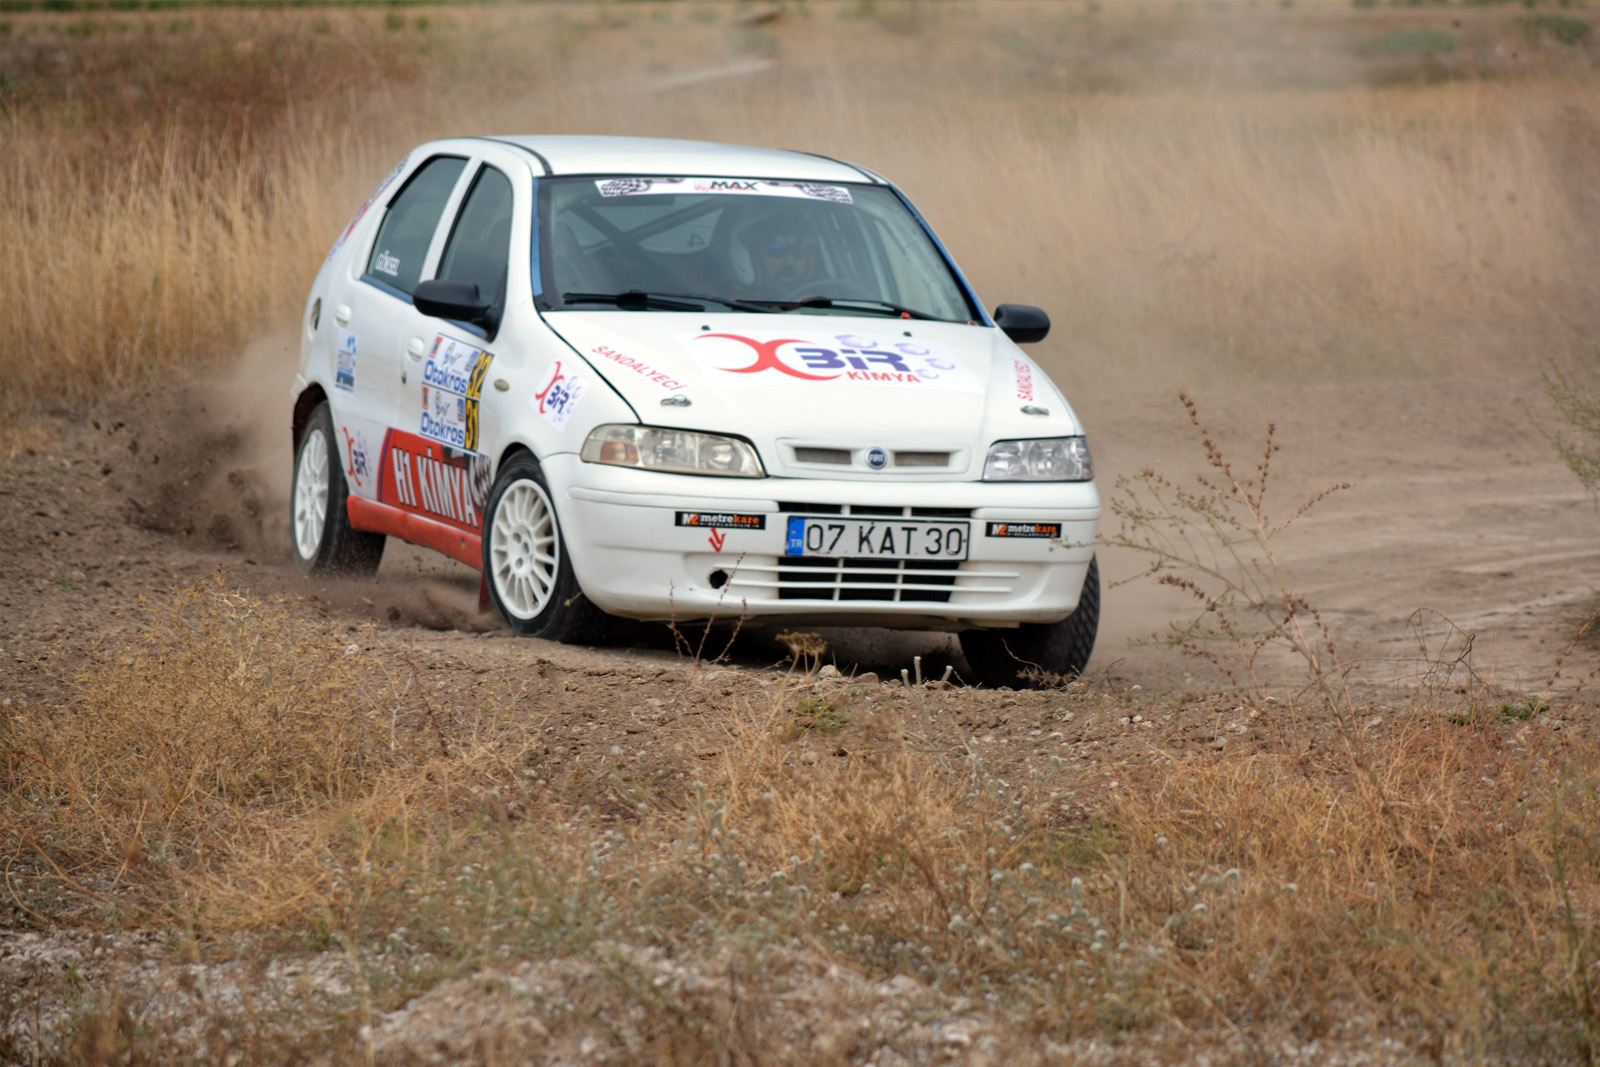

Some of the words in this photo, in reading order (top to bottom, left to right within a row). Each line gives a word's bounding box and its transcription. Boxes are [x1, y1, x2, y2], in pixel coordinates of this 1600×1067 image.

[711, 181, 759, 192] MAX
[424, 359, 468, 395] Otokros
[421, 411, 465, 445] Otokros
[465, 399, 479, 451] 31
[416, 446, 479, 528] KİMYA
[701, 514, 760, 525] metrekare
[1008, 523, 1057, 533] metrekare
[791, 538, 803, 549] TR
[806, 524, 846, 552] 07
[858, 525, 918, 555] KAT
[925, 527, 963, 556] 30
